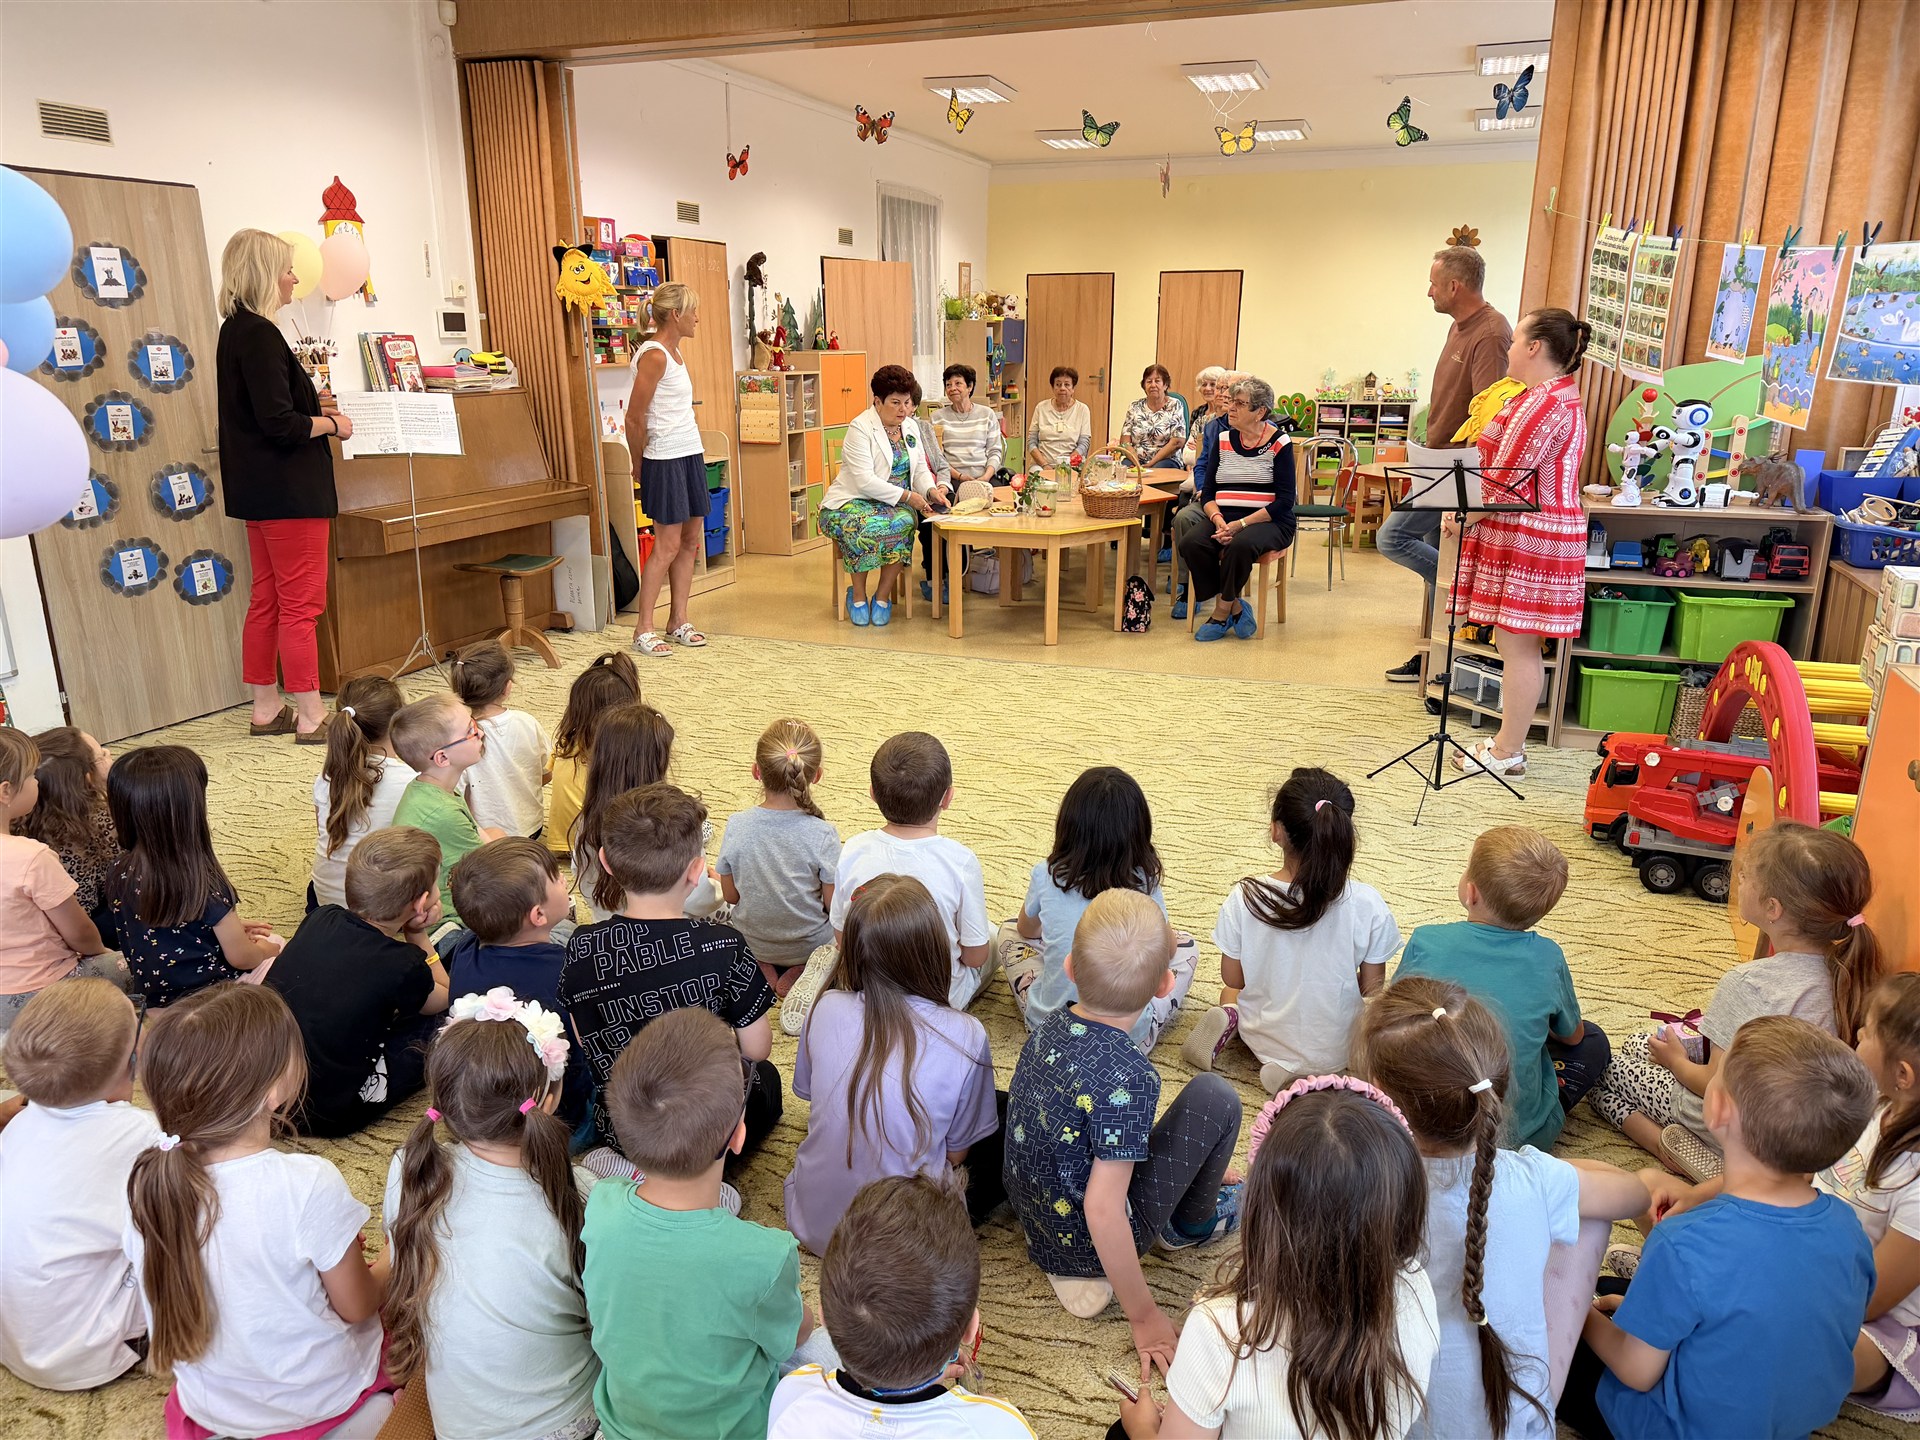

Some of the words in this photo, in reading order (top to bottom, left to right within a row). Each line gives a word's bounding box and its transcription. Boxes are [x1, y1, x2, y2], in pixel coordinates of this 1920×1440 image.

[593, 931, 695, 981] PABLE
[598, 972, 721, 1027] UNSTOP
[1032, 1091, 1044, 1102] TNT
[1115, 1151, 1134, 1159] TNT
[1058, 1170, 1072, 1178] NT
